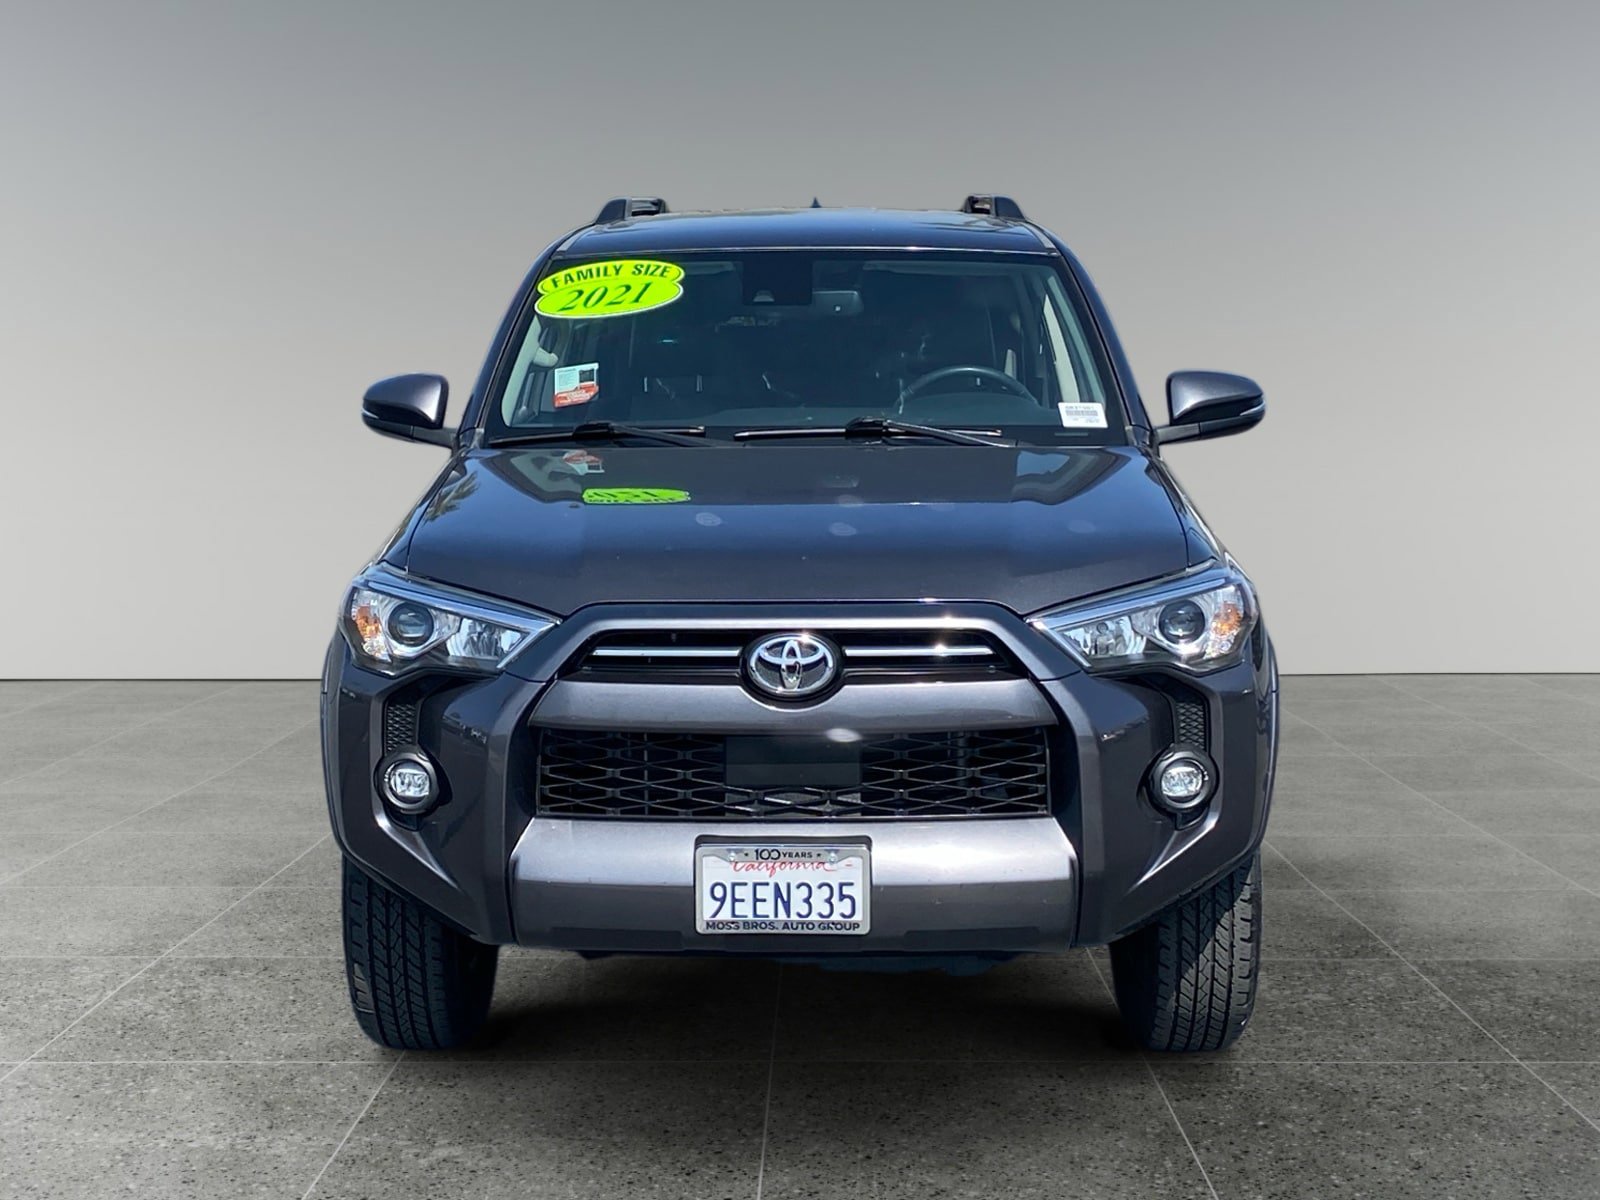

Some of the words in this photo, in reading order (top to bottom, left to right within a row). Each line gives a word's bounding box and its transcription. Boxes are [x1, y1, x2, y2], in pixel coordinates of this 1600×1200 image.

[550, 264, 623, 288] FAMILY
[631, 263, 672, 278] SIZE
[556, 281, 653, 312] 2021
[754, 848, 781, 861] 100
[781, 851, 813, 859] YEARS
[709, 881, 856, 919] 9EEN335
[705, 921, 740, 931] MOSS
[742, 921, 779, 931] BROS.
[782, 921, 816, 931] AUTO
[818, 921, 860, 931] GROUP
